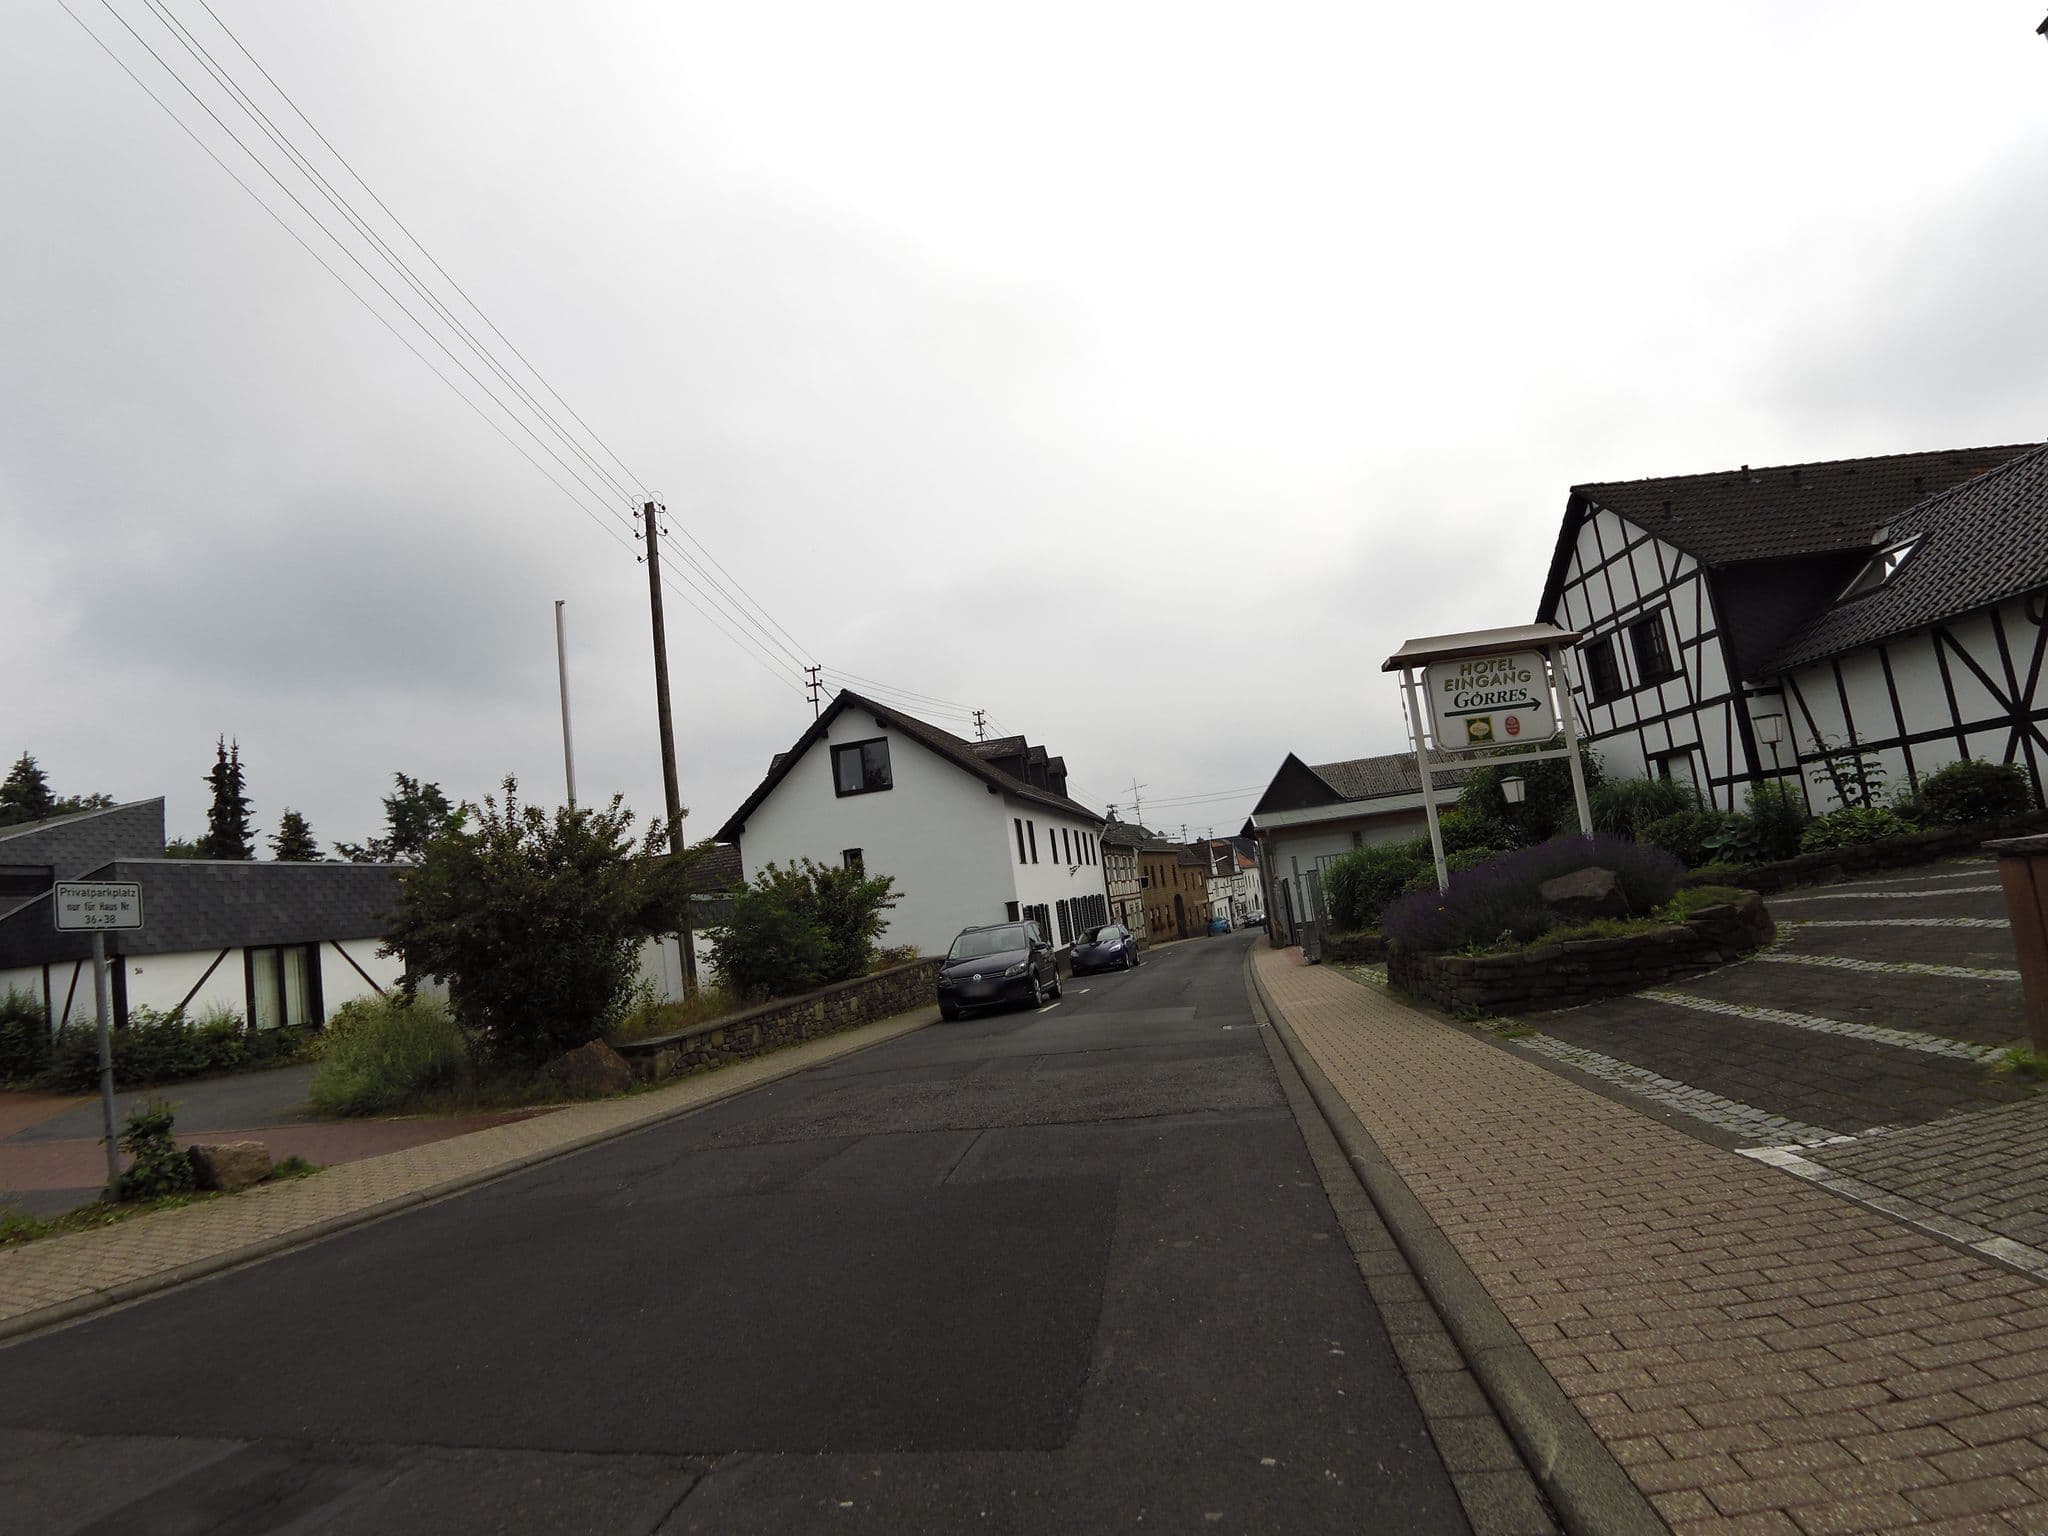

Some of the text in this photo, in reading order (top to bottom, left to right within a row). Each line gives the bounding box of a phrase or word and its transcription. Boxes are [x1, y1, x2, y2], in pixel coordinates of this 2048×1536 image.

[1460, 658, 1516, 676] HOTEL
[1444, 670, 1531, 692] EINGANG
[60, 887, 136, 899] Privatparkplatz
